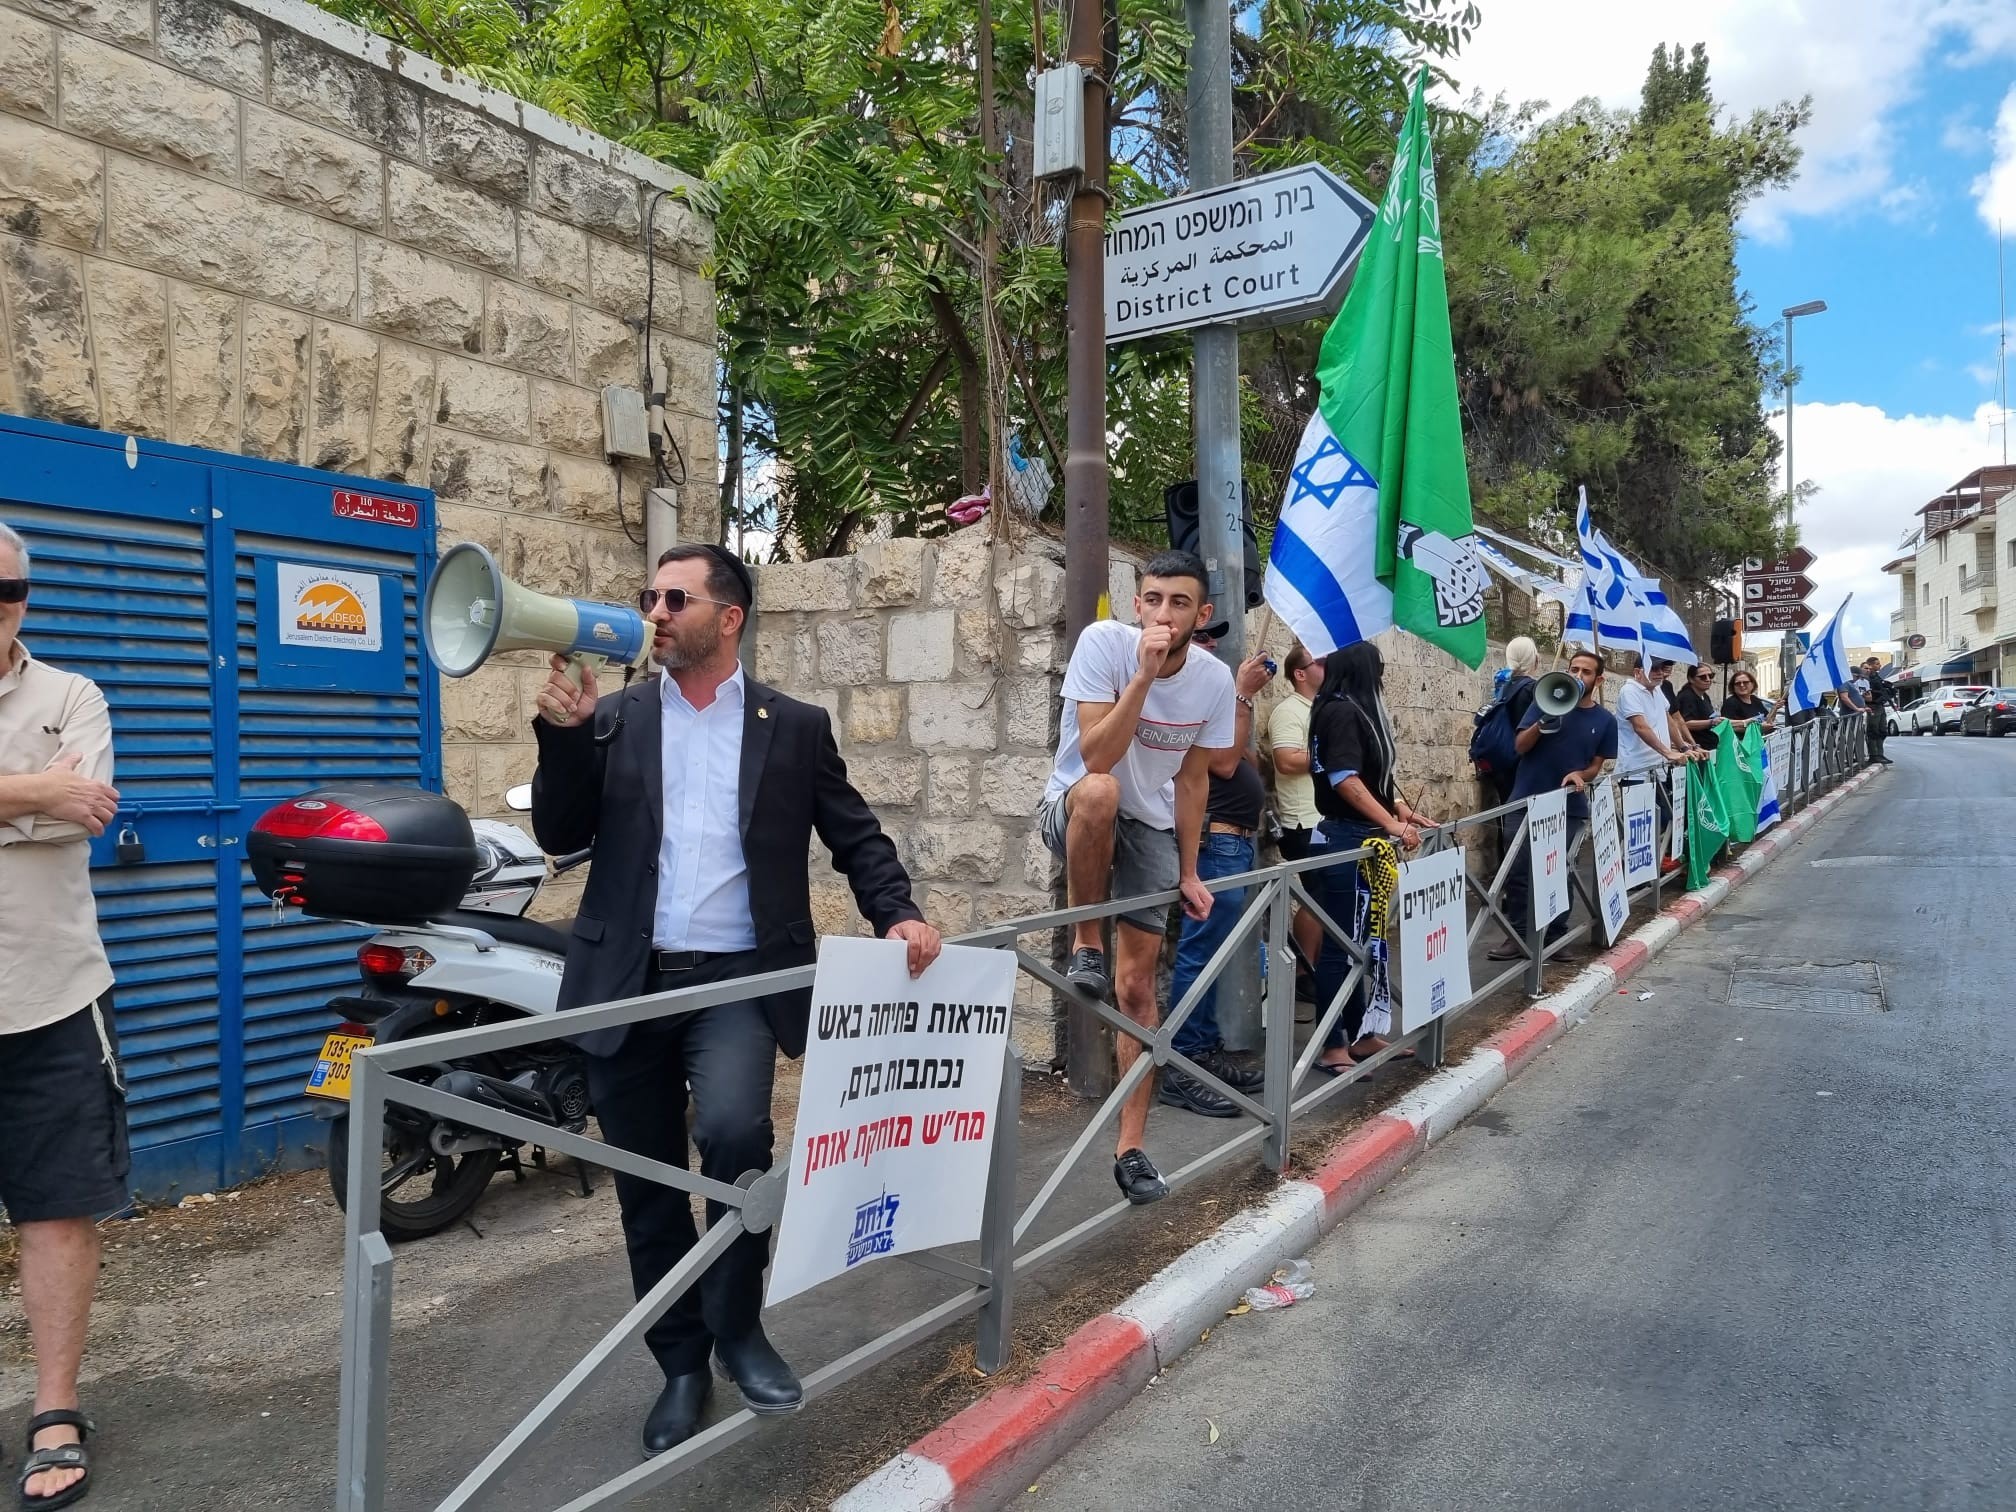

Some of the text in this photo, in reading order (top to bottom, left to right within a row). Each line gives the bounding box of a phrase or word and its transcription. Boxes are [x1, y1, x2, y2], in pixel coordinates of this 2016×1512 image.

[1275, 184, 1315, 218] בית
[1176, 197, 1262, 241] המשפט
[1121, 230, 1293, 287] المحكمة المركزية
[1117, 264, 1300, 322] District Court
[339, 504, 411, 523] محطة المطران
[361, 496, 373, 507] 110
[397, 503, 406, 512] 15
[1766, 592, 1799, 600] National
[1768, 577, 1796, 586] נשיונל
[330, 612, 364, 624] JDECO
[1768, 620, 1799, 628] Victoria
[285, 633, 314, 642] Jerusalem
[333, 635, 357, 647] Electricity
[1404, 880, 1447, 921] מפקירים
[1449, 868, 1463, 903] לא
[1426, 920, 1448, 961] לוחם
[817, 1001, 1007, 1041] הוראות פתיחה באש
[840, 1058, 965, 1108] נכתבות בדם,
[804, 1128, 851, 1186] אותן
[852, 1115, 912, 1166] מוחקת
[873, 1233, 891, 1252] לא
